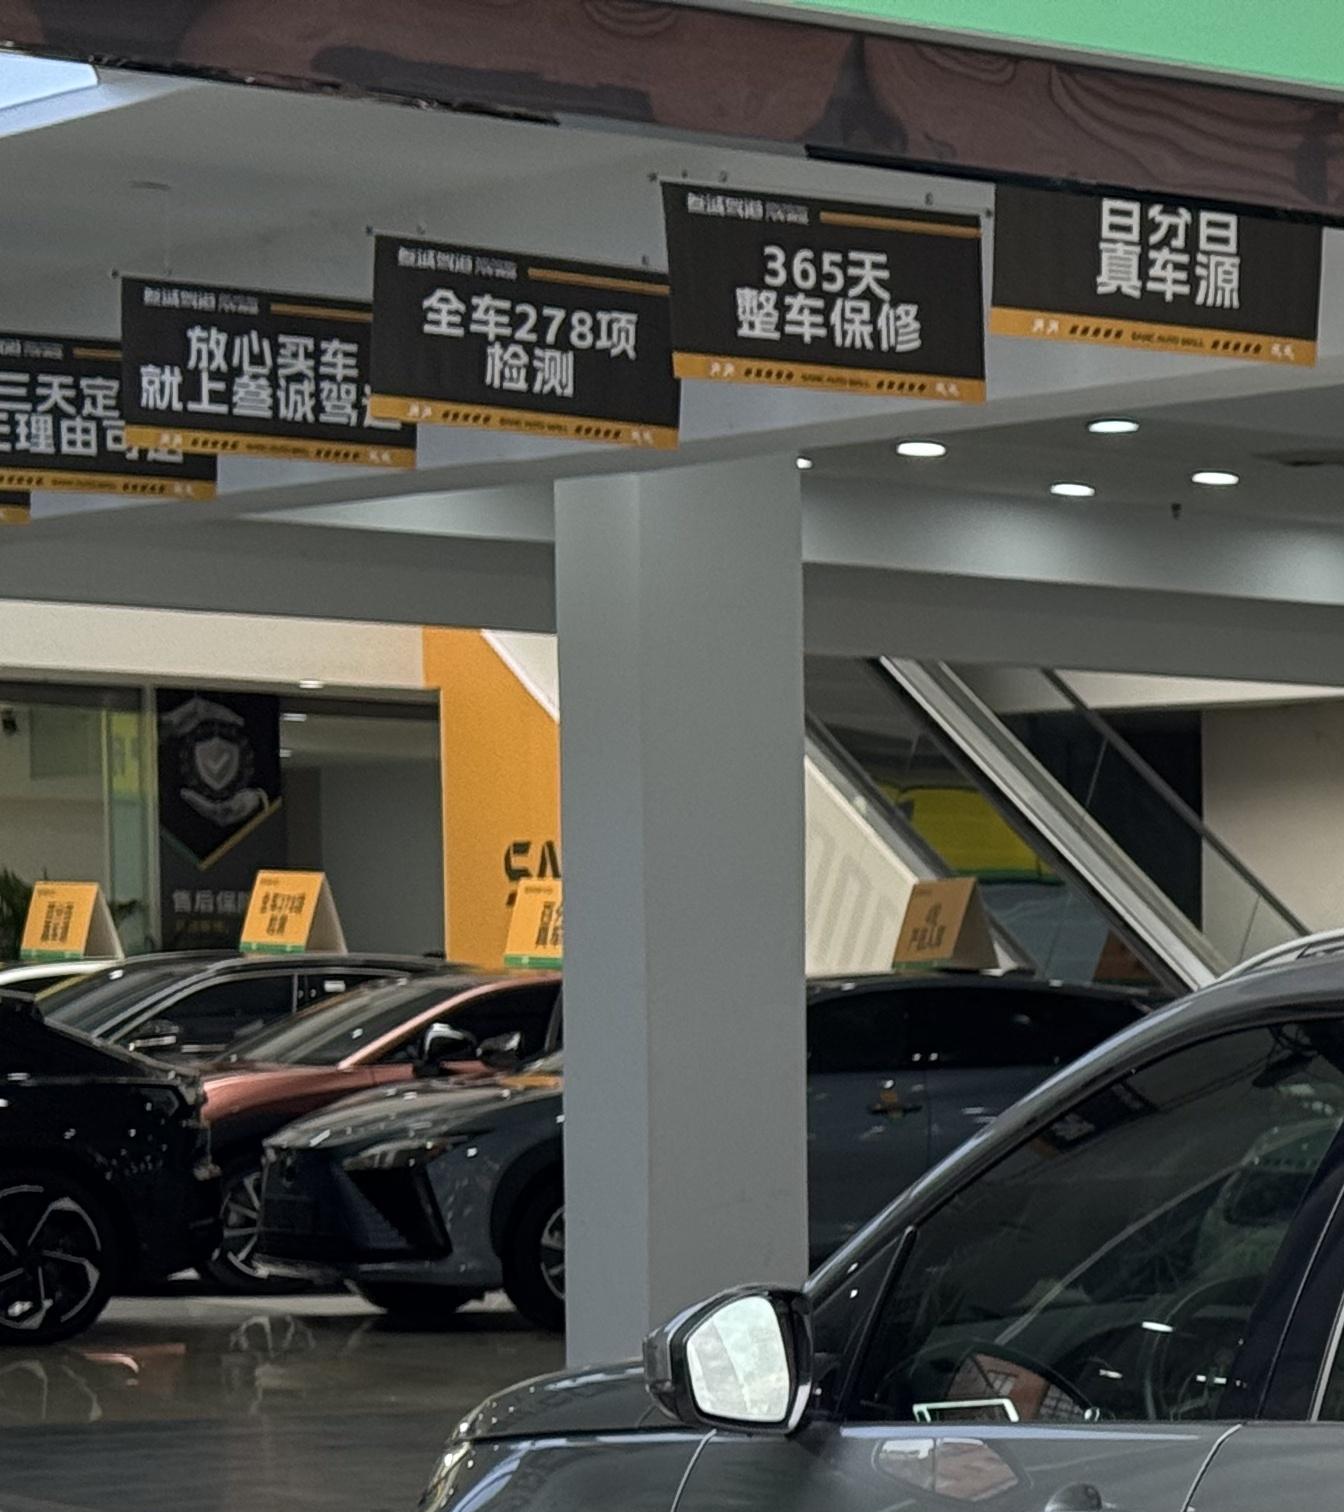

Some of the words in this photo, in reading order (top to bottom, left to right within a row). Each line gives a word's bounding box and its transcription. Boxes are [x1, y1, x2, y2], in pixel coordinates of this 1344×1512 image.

[763, 245, 891, 301] 365天
[1097, 242, 1240, 309] 真车源
[422, 288, 638, 360] 全车278项
[736, 287, 922, 352] 整车保修
[186, 325, 359, 382] 放心买车
[485, 341, 574, 398] 检测
[0, 371, 121, 418] 三天定
[0, 411, 184, 463] 理由可
[173, 890, 249, 913] 售后保
